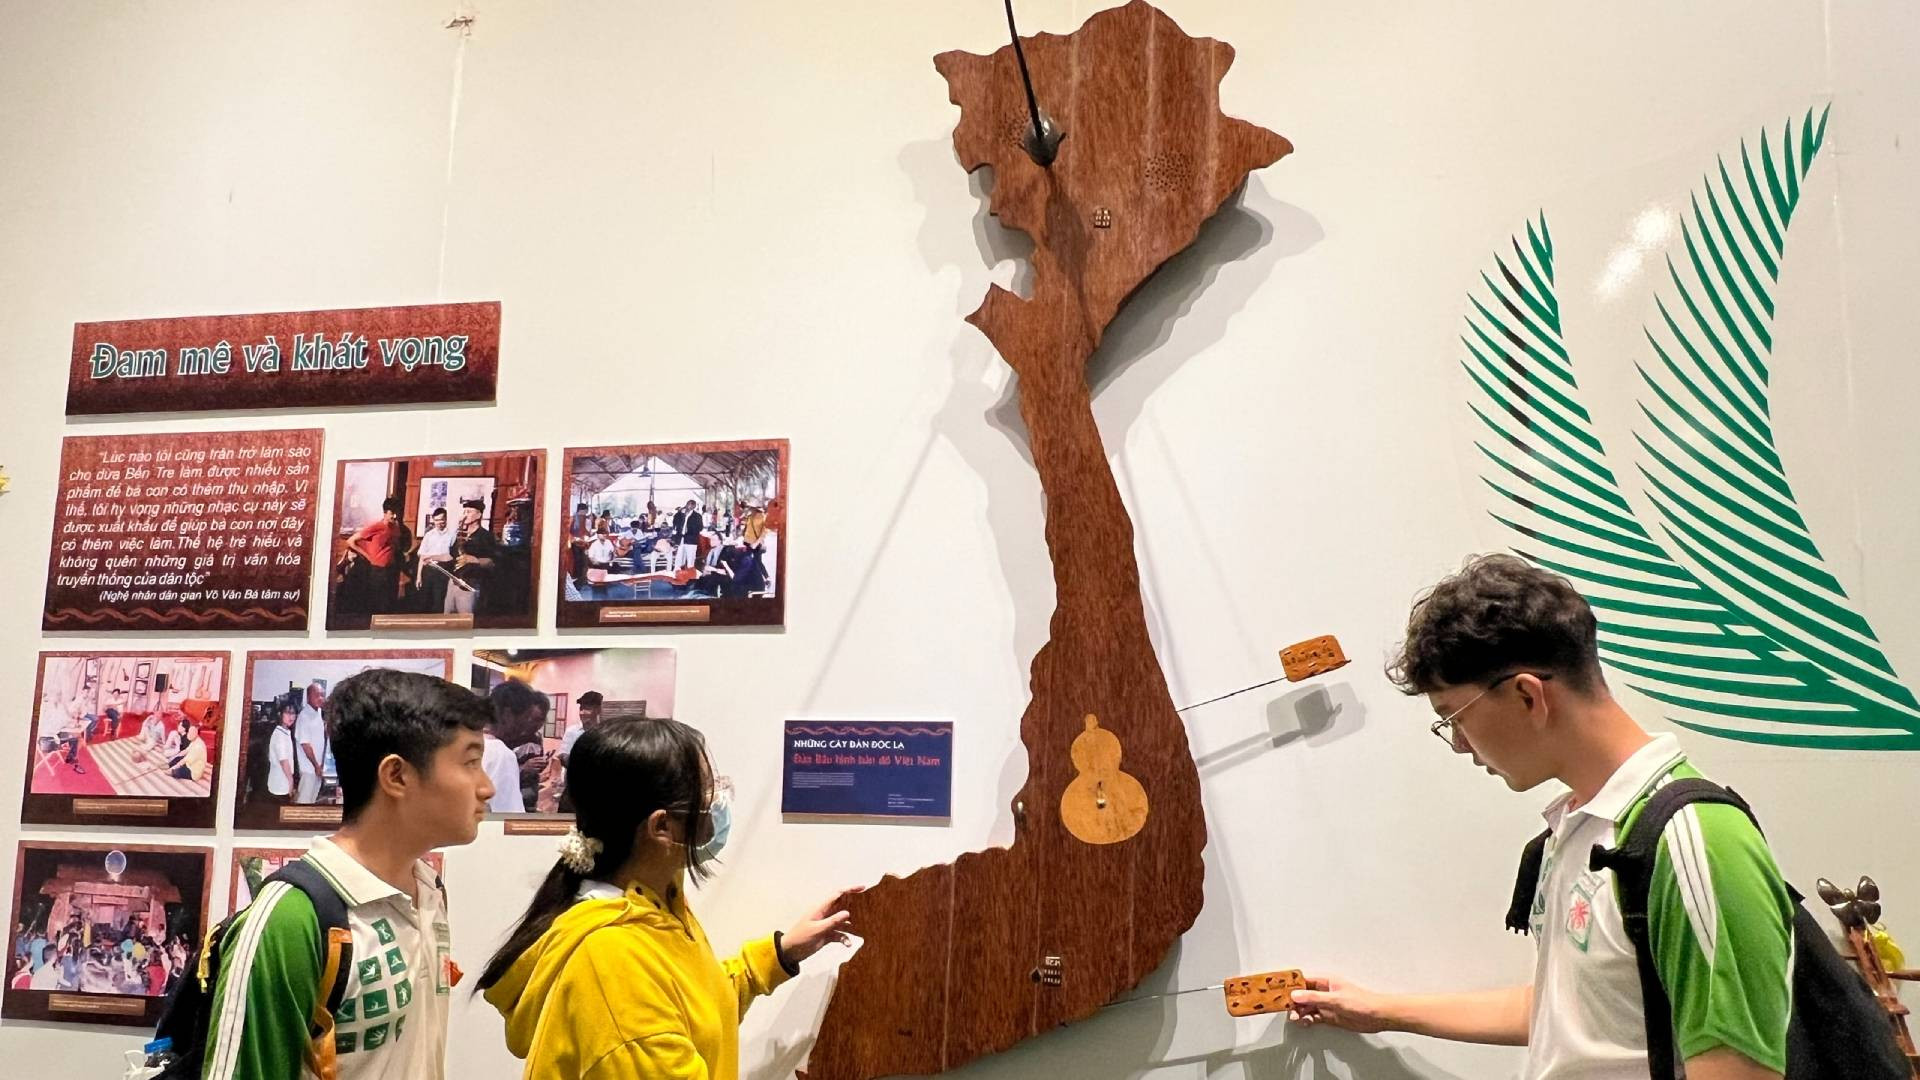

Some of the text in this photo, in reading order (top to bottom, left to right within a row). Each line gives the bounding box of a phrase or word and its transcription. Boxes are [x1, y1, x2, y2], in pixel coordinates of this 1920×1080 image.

[90, 332, 469, 379] Đam mê và khát vọng
[175, 448, 205, 463] cũng
[69, 469, 91, 480] cho
[157, 467, 175, 478] Tre
[208, 466, 240, 477] được
[67, 483, 101, 500] phẩm
[106, 483, 121, 497] để
[146, 486, 168, 496] con
[228, 483, 248, 494] thu
[111, 504, 126, 518] hy
[130, 505, 158, 518] vọng
[63, 521, 94, 533] được
[161, 517, 178, 531] để
[230, 520, 253, 530] con
[258, 518, 278, 529] nơi
[82, 540, 112, 550] thêm
[208, 537, 223, 550] hệ
[59, 556, 97, 569] không
[105, 557, 136, 569] quên
[145, 555, 186, 569] những
[134, 573, 157, 585] của
[180, 591, 201, 602] gian
